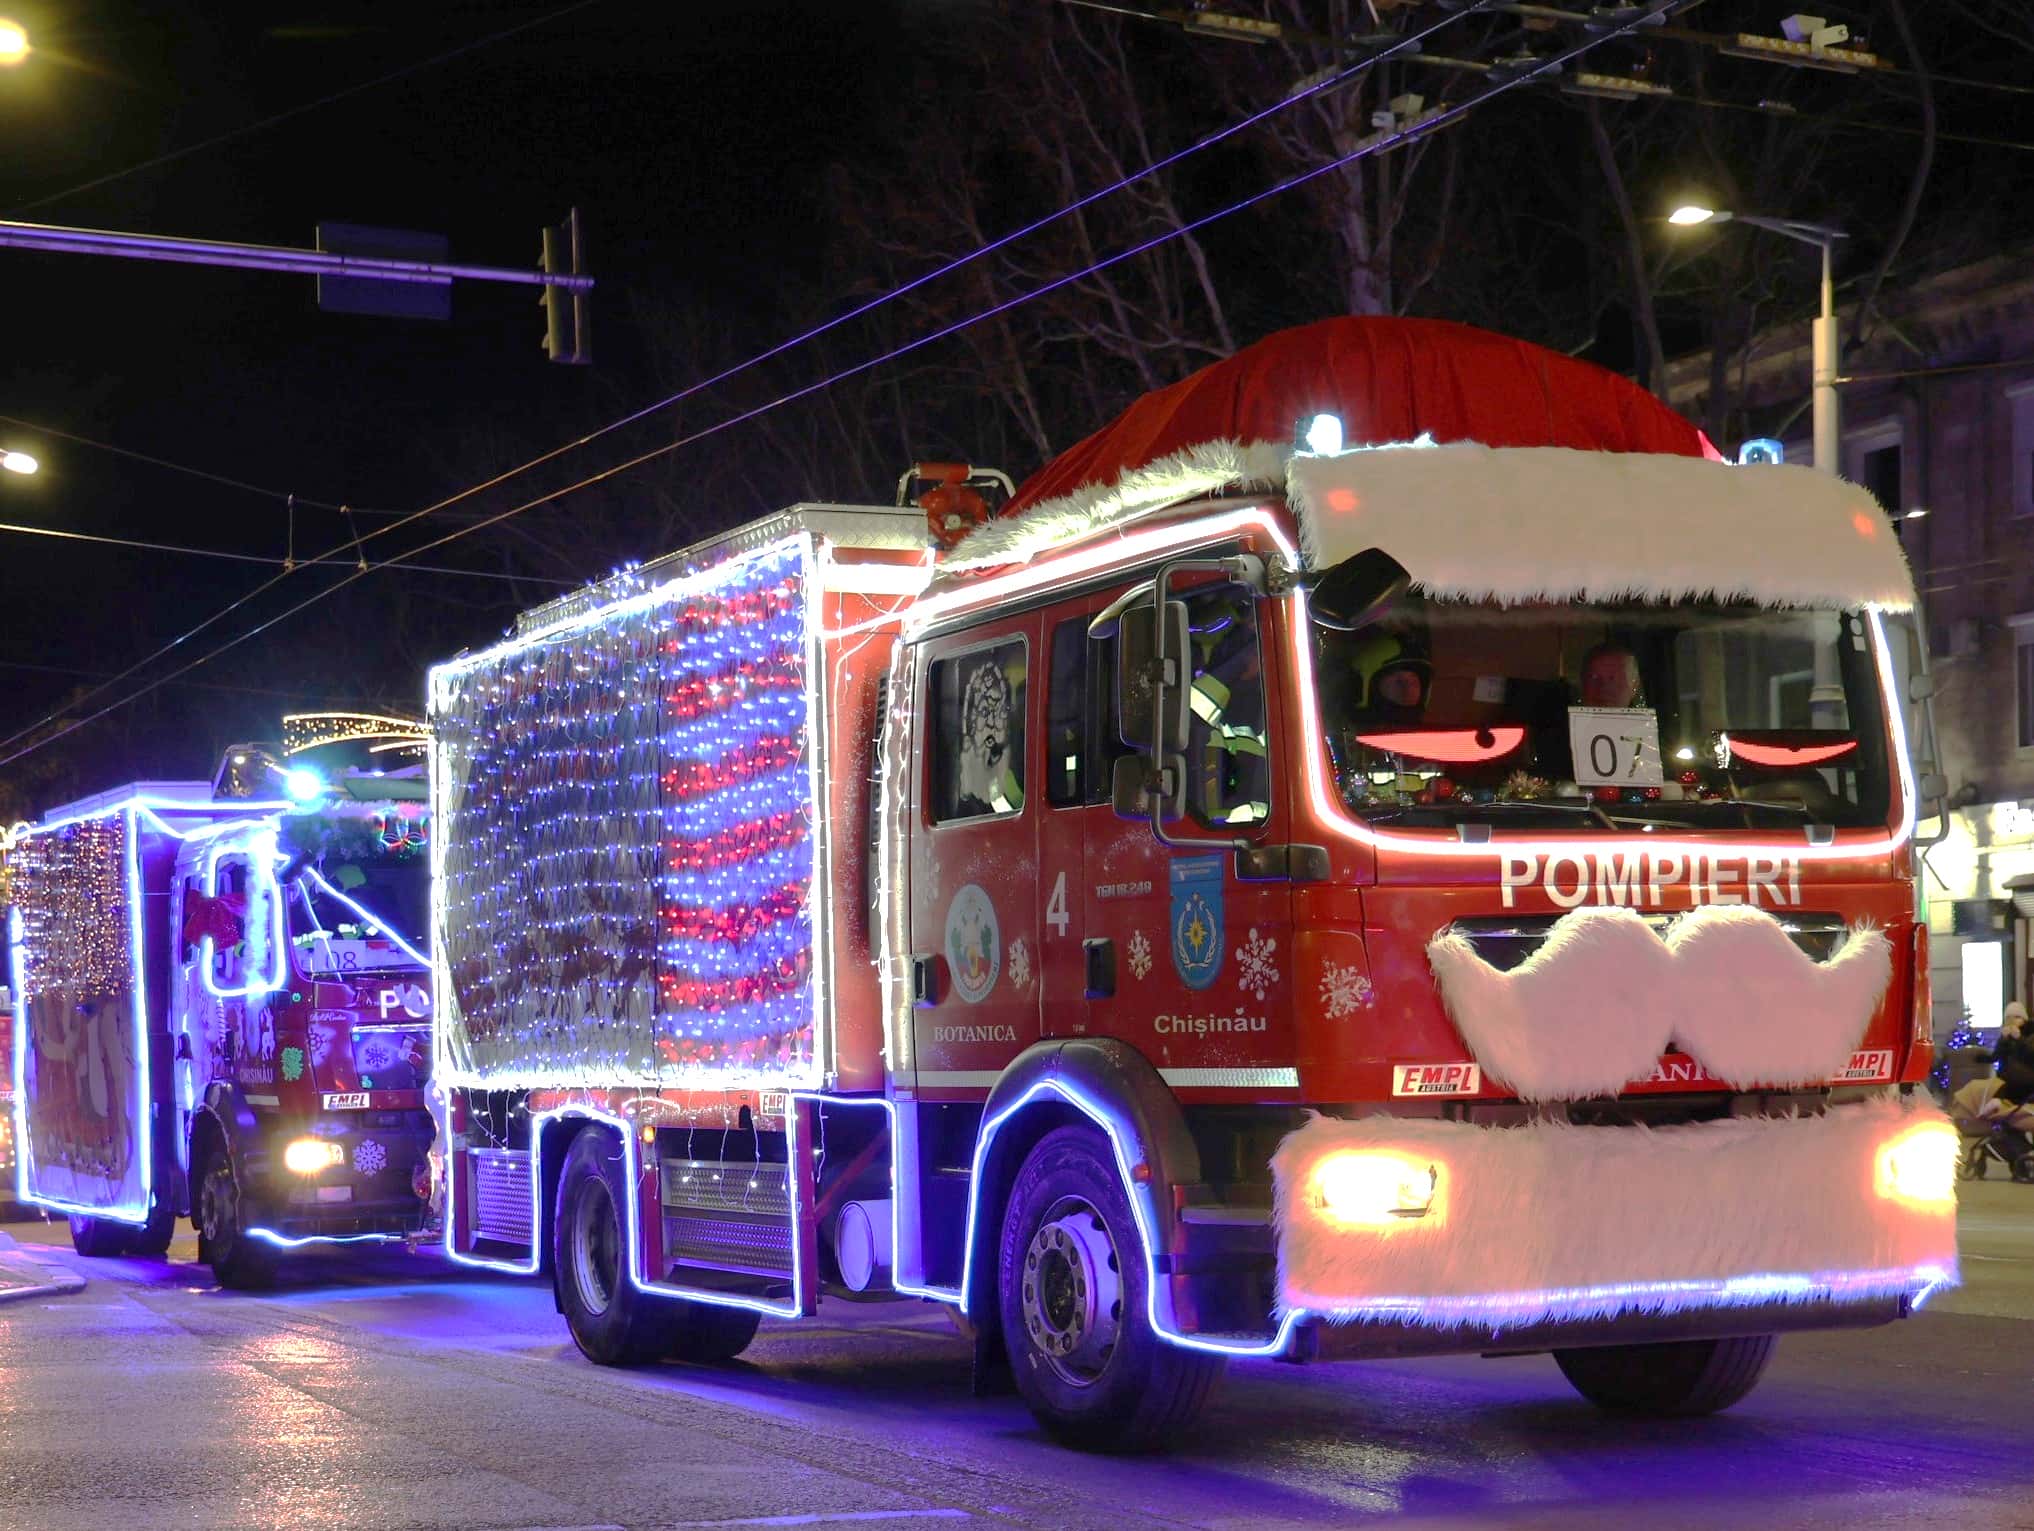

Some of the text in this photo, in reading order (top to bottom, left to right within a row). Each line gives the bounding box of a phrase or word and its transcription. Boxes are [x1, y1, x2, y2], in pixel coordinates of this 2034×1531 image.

[1590, 733, 1643, 779] 07
[1500, 852, 1801, 909] POMPIERI
[1046, 871, 1070, 937] 4
[326, 951, 358, 969] 08
[934, 1023, 1017, 1042] BOTANICA
[1838, 1053, 1887, 1077] MPL
[1401, 1066, 1473, 1093] EMPL
[1417, 1083, 1458, 1093] AUSTRIA
[328, 1094, 366, 1108] EMPL
